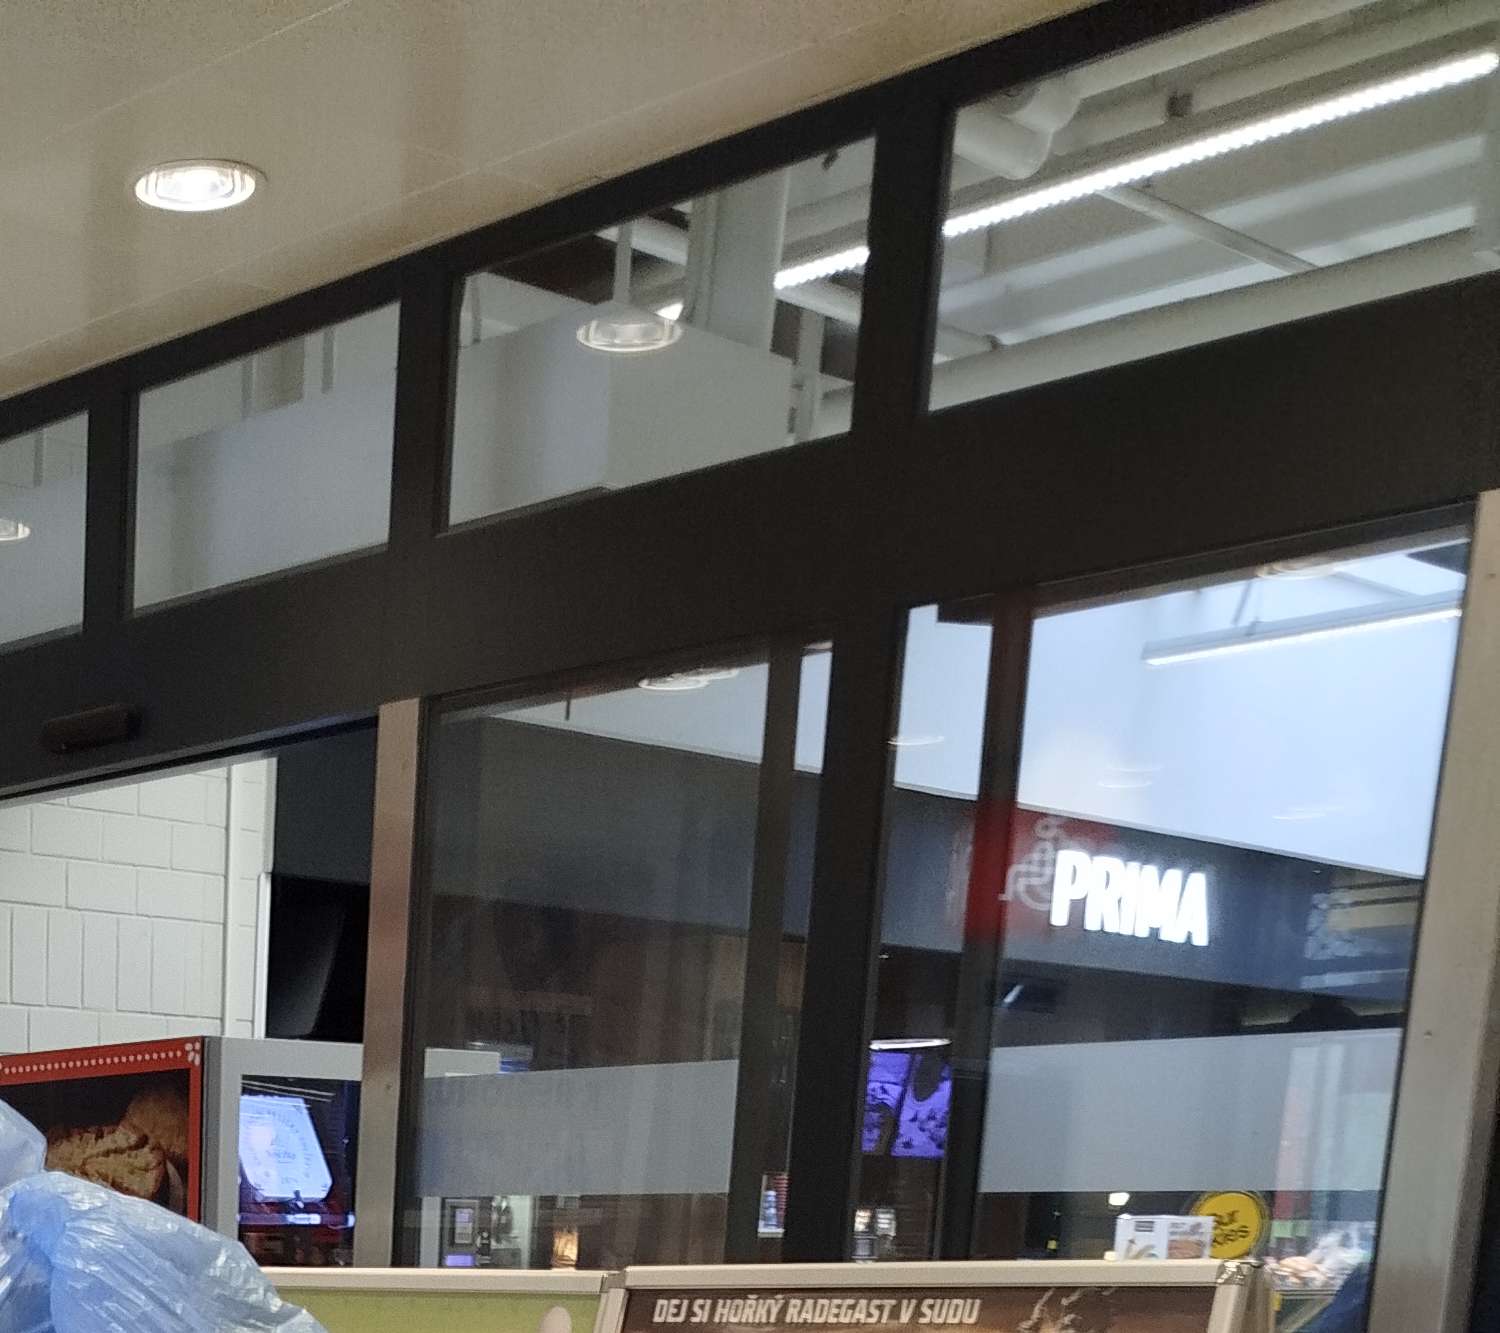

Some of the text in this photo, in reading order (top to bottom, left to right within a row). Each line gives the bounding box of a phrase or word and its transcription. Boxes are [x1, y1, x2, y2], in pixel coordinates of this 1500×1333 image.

[1049, 847, 1210, 947] PRIMA
[652, 1294, 982, 1326] DEJ SI HOŘKÝ RADEGAST V SUDU
